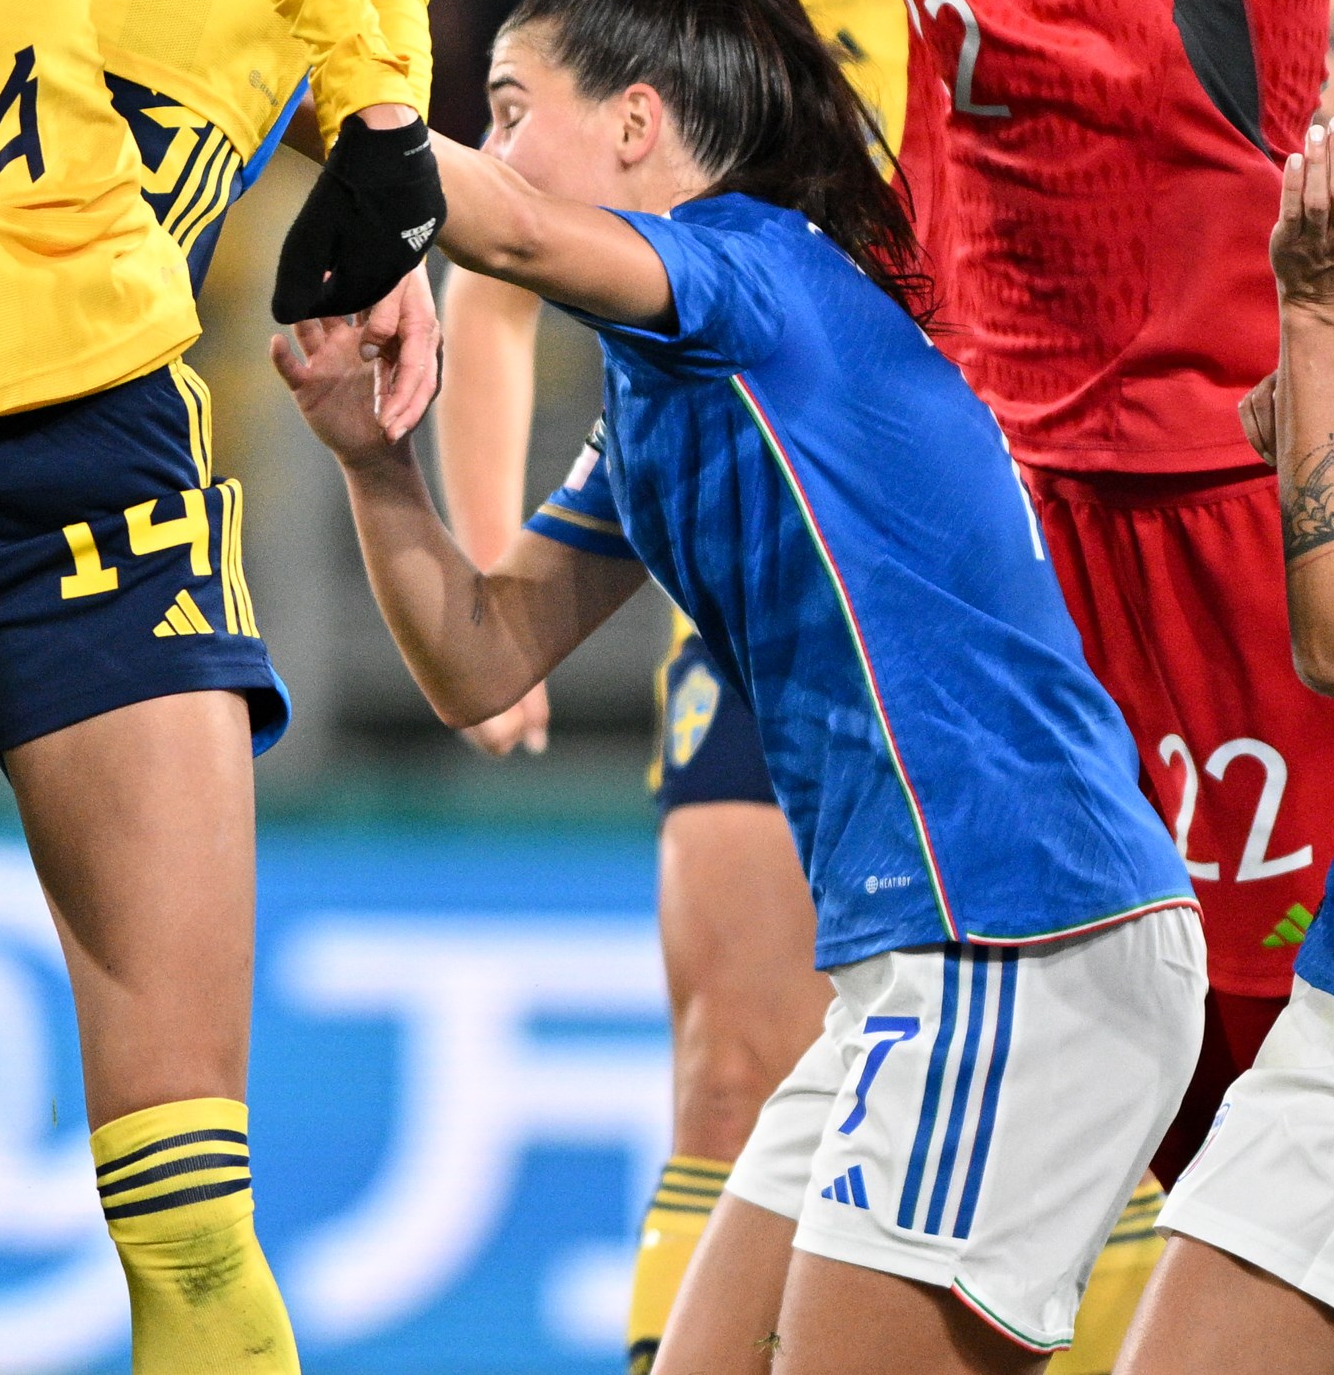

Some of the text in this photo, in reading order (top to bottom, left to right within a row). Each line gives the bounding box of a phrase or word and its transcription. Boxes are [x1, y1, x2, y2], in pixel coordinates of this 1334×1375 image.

[60, 488, 212, 600] 14
[1158, 733, 1313, 883] 22
[862, 1016, 920, 1136] 7
